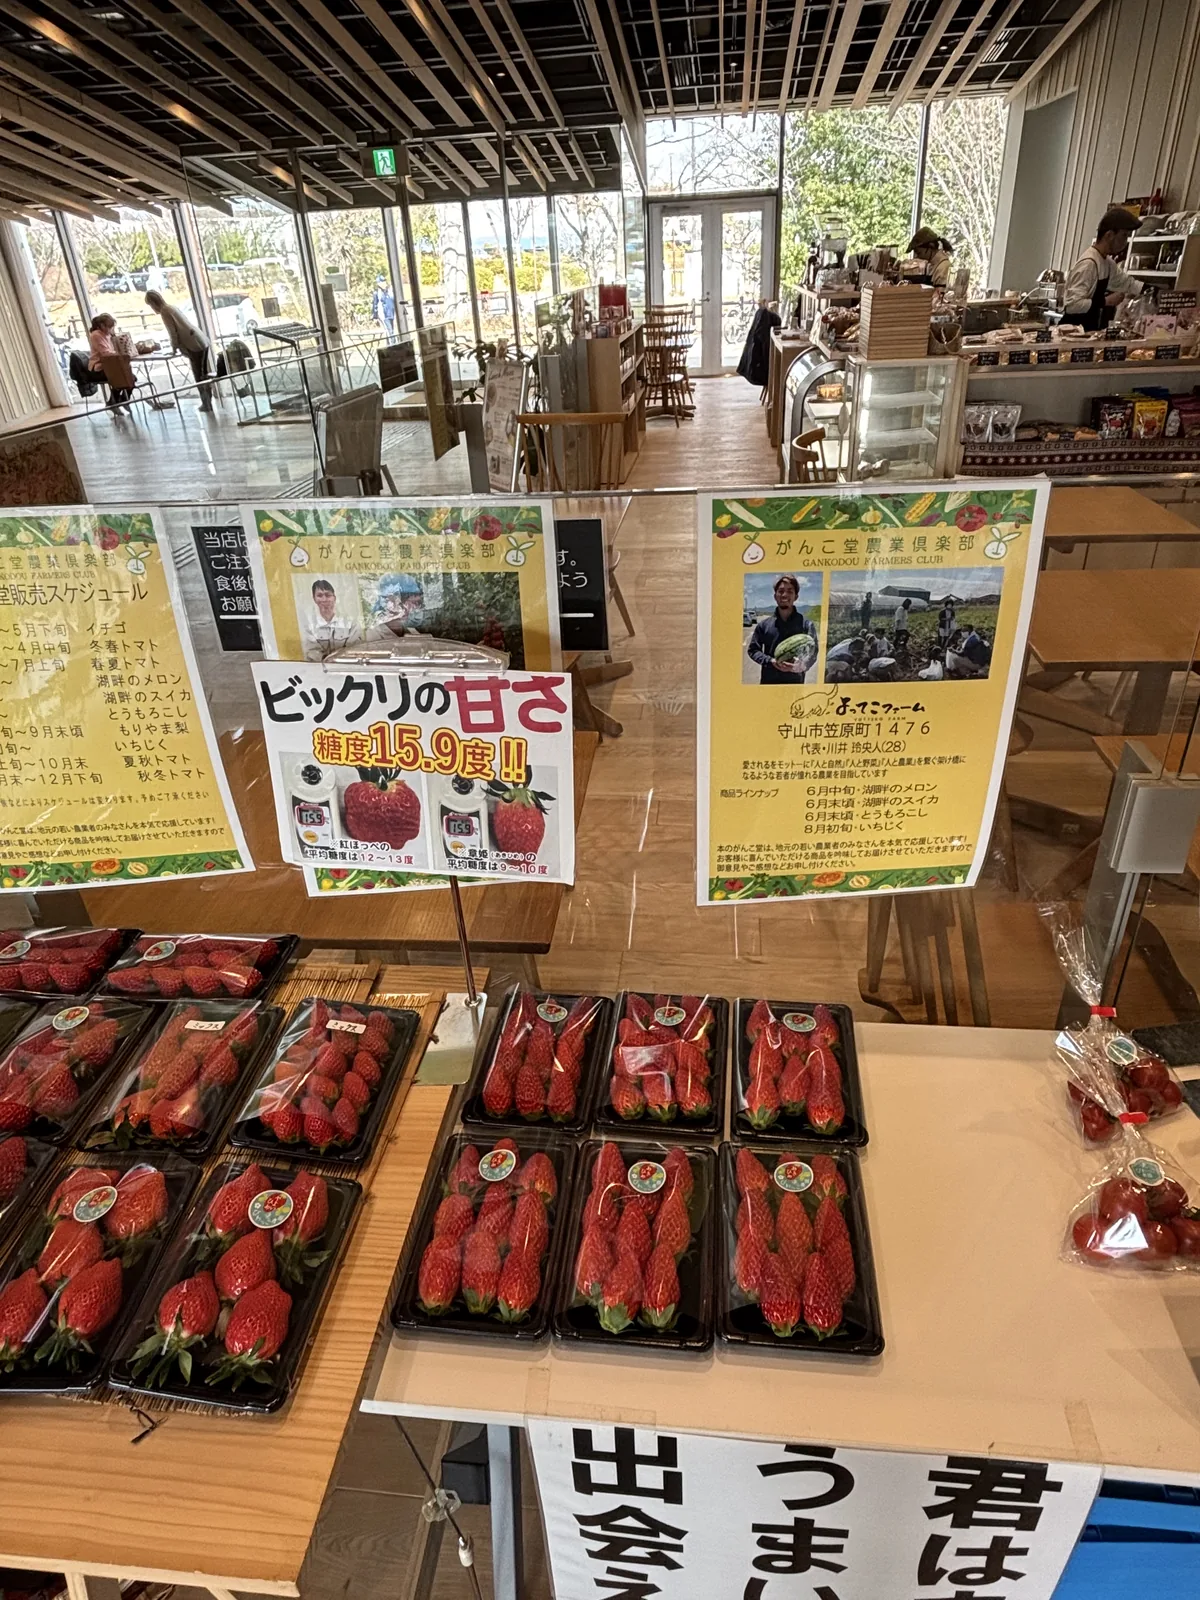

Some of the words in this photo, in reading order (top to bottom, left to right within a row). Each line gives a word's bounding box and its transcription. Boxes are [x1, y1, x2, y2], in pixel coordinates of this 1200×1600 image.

[776, 534, 975, 555] がんこ堂農業倶楽部
[802, 557, 860, 567] GANKODOU
[864, 556, 913, 566] FARMERS
[916, 555, 944, 565] CLUB
[73, 569, 96, 579] CLUB
[214, 575, 253, 591] 食後
[86, 621, 126, 636] イチゴ
[89, 639, 158, 653] 冬春トマト
[91, 657, 160, 671] 春夏トマト
[96, 674, 182, 689] 湖畔のメロン
[103, 690, 192, 705] 湖畔のスイカ
[260, 675, 568, 733] ビックリの甘さ
[109, 706, 188, 721] とうもろこし
[119, 721, 190, 737] もりやま梨
[115, 738, 168, 752] いちじく
[122, 753, 191, 768] 夏秋トマト
[137, 768, 206, 783] 秋冬トマト
[720, 788, 780, 798] 商品ラインナップ
[914, 1455, 1064, 1600] 君は
